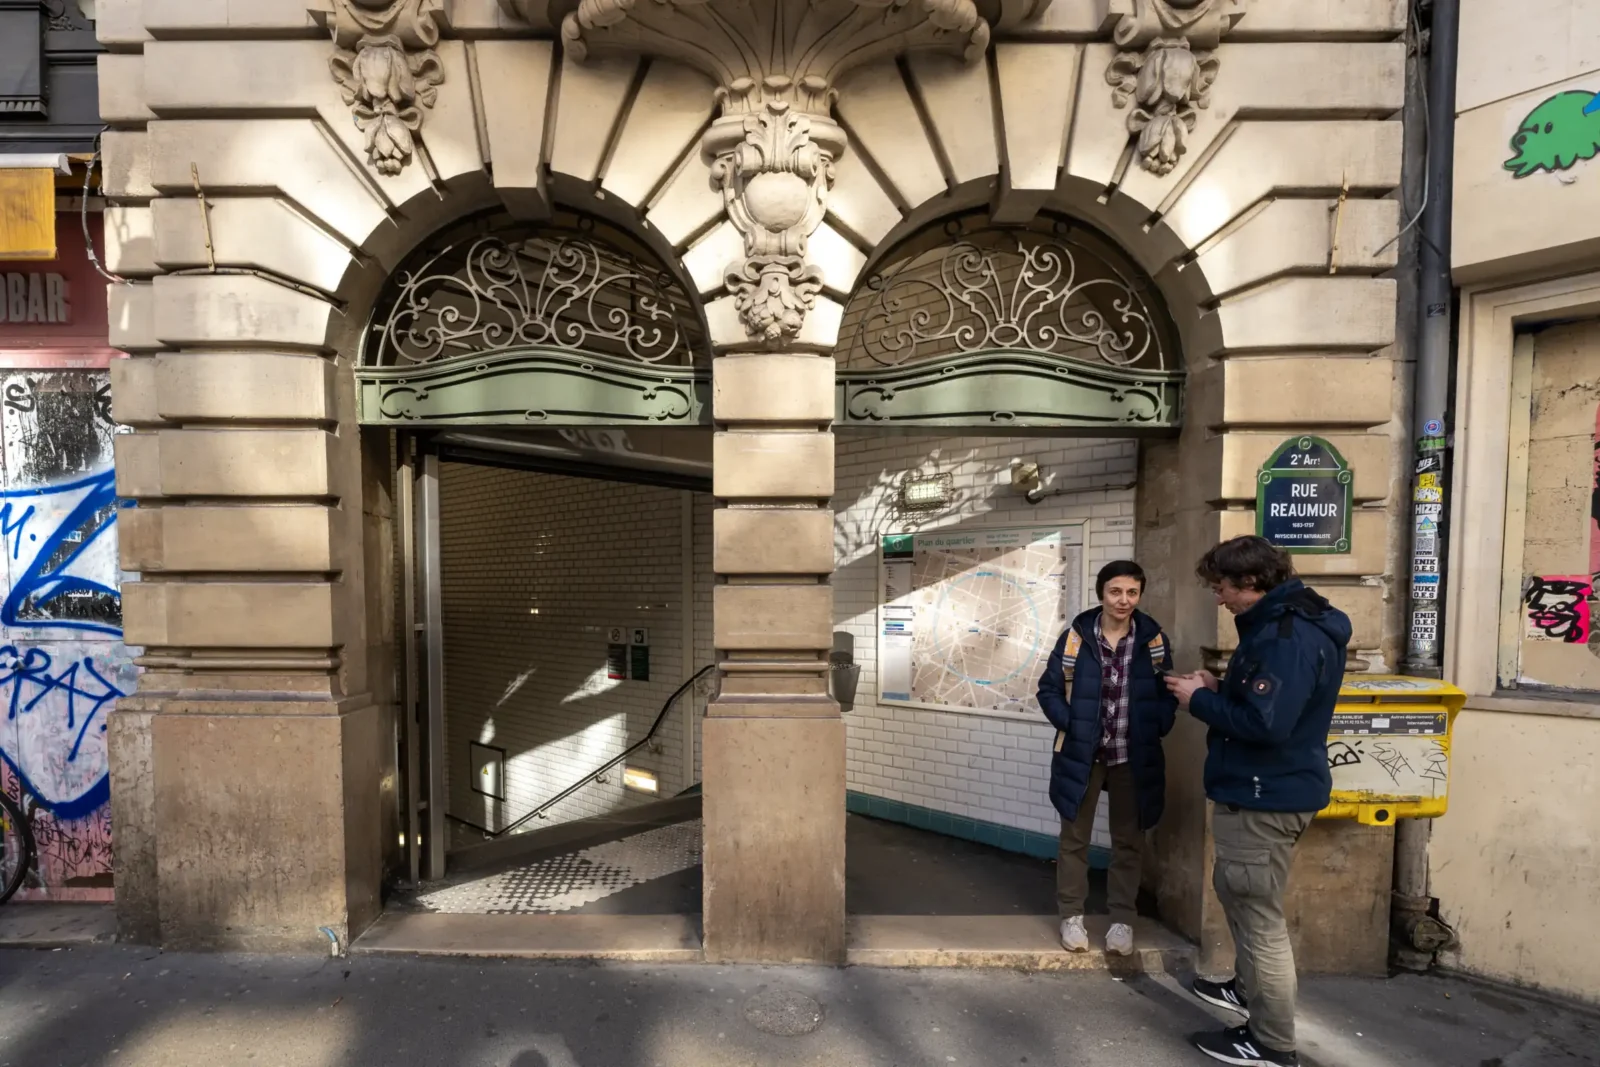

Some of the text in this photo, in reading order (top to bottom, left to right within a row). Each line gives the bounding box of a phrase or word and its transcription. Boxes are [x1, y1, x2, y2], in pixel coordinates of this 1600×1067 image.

[1291, 484, 1318, 497] RUE
[1270, 503, 1338, 517] REAUMUR
[935, 536, 944, 545] du
[946, 536, 976, 548] quartier
